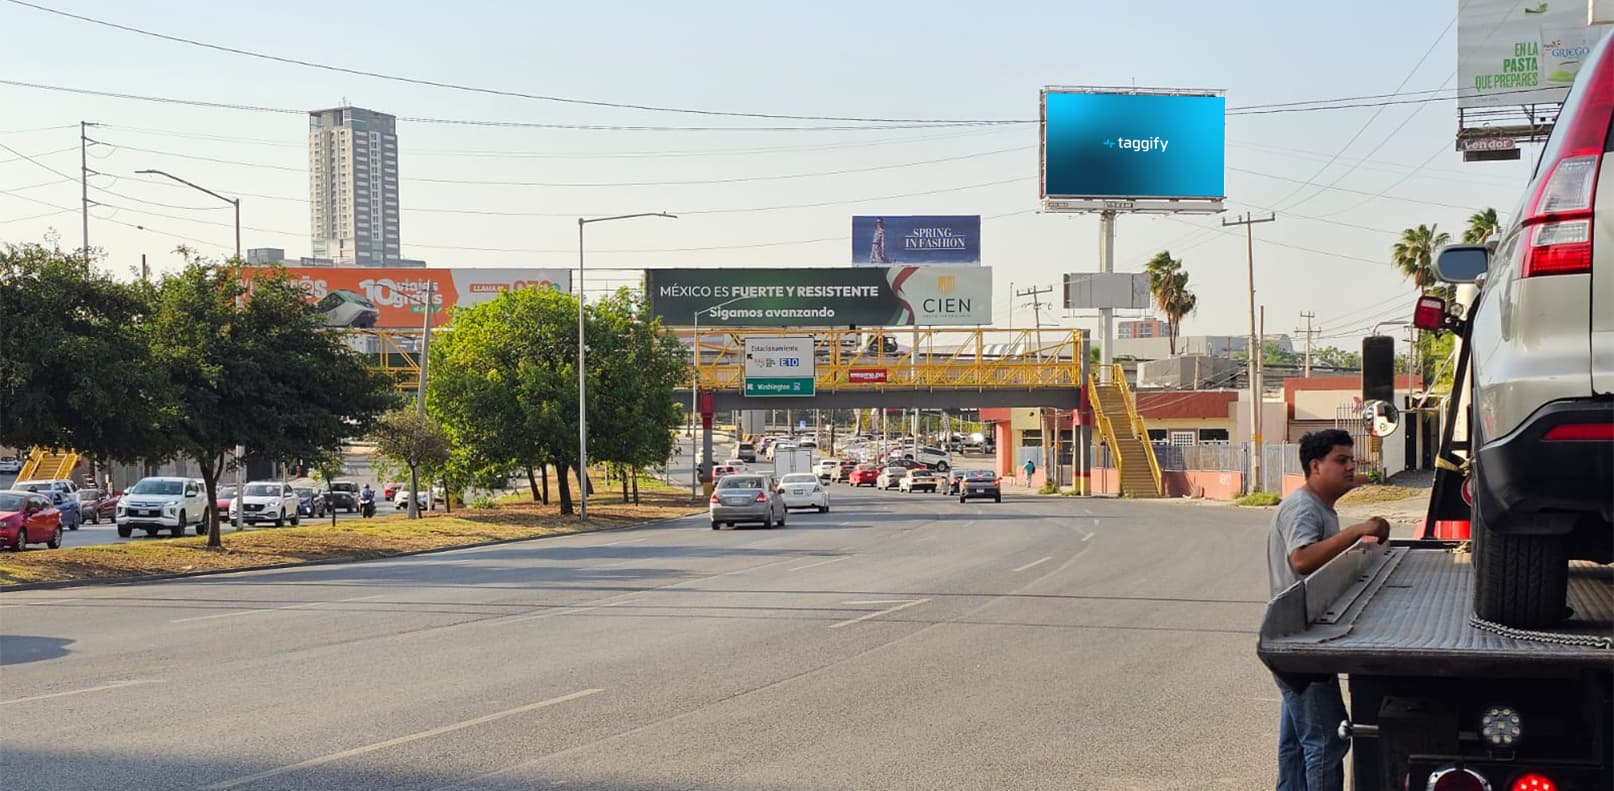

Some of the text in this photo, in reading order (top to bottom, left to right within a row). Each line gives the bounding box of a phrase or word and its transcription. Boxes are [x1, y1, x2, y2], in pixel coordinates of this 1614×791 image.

[1514, 42, 1527, 57] EN
[1527, 41, 1539, 56] LA
[1552, 46, 1590, 58] GRIEGO
[1503, 57, 1539, 73] PASTA
[1475, 71, 1539, 92] QUE PREPARES
[1118, 136, 1169, 153] taggify
[912, 227, 952, 238] SPRING
[905, 238, 966, 248] IN FASHION
[359, 278, 394, 306] 10
[660, 283, 879, 297] MÉXICO ES FUERTE Y RESISTENTE
[393, 292, 443, 309] grats
[923, 298, 971, 313] CIEN
[709, 306, 835, 320] Sigamos avanzando
